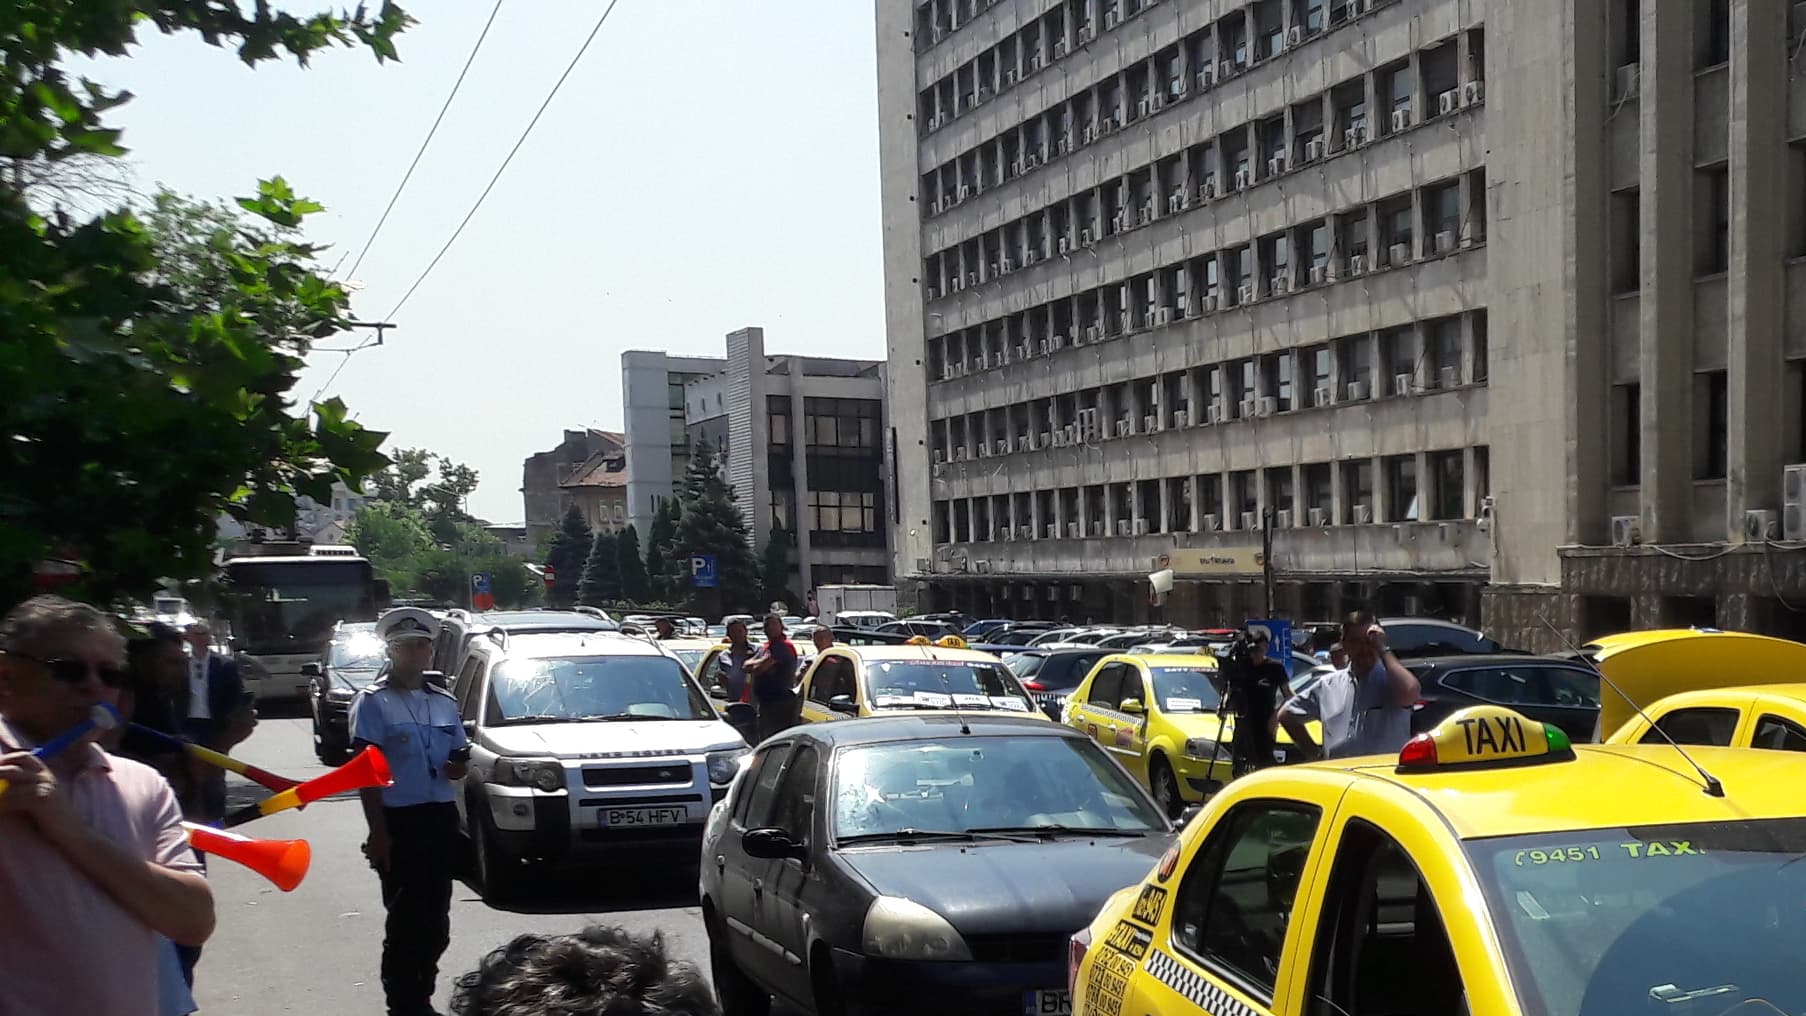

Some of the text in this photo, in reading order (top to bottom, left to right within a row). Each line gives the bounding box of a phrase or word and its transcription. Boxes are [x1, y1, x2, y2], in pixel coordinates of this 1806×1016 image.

[692, 557, 706, 575] P
[1456, 716, 1527, 756] TAXI
[609, 811, 620, 825] B
[626, 811, 644, 825] 54
[648, 810, 681, 824] HFV
[1529, 846, 1601, 866] 9451
